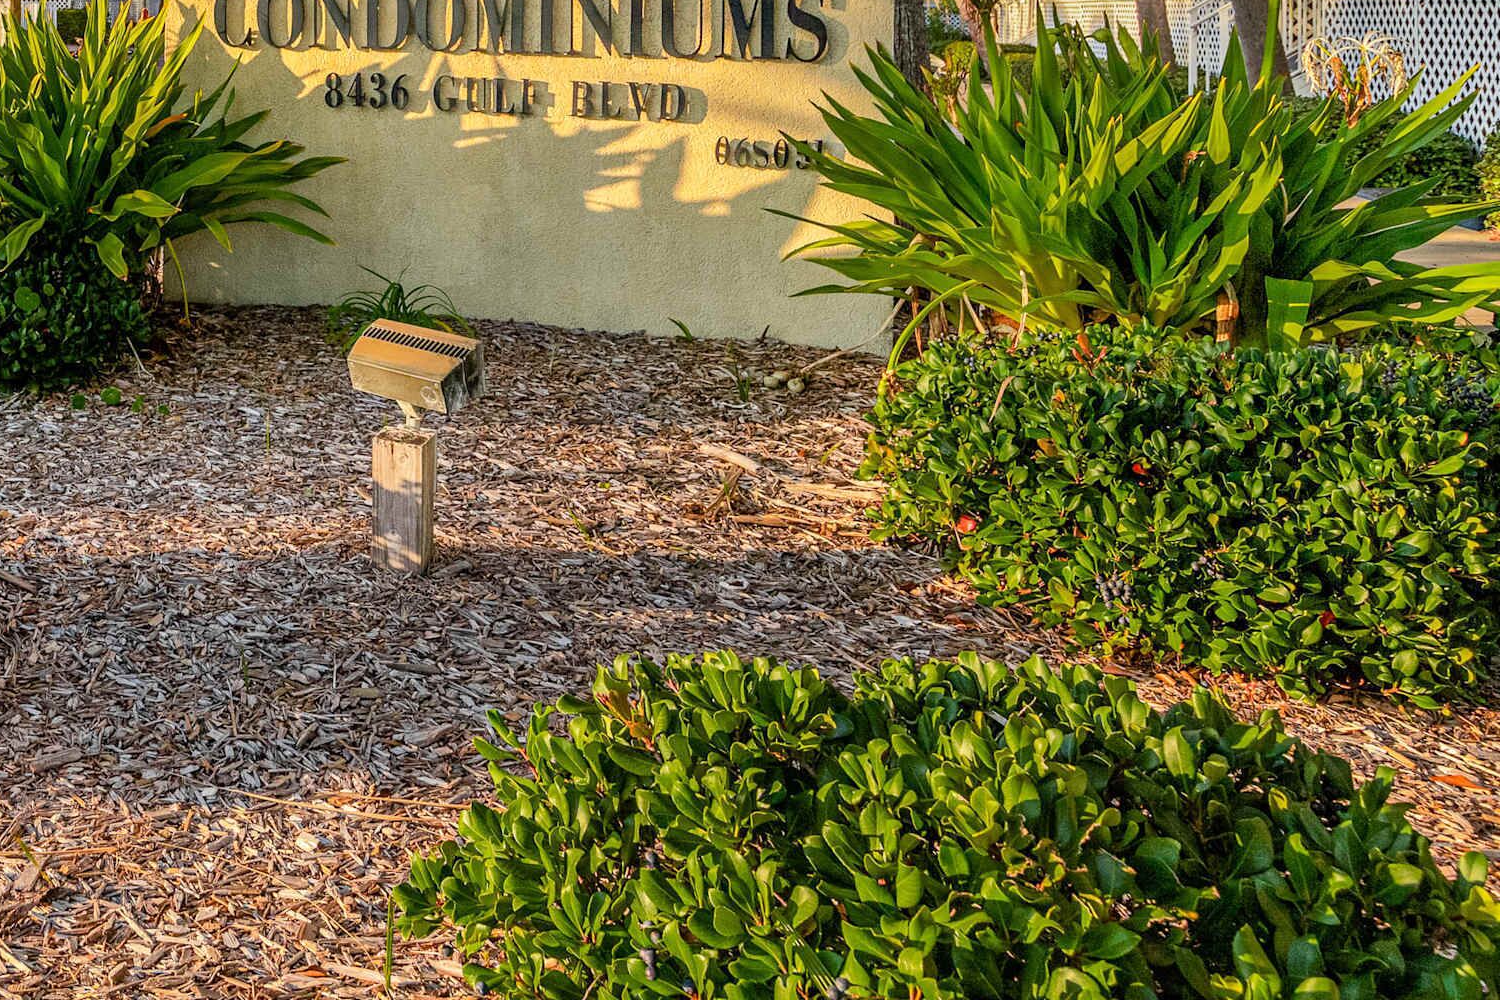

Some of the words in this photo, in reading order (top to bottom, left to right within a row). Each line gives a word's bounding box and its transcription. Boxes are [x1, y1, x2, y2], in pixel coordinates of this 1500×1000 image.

[324, 72, 410, 111] 8436
[433, 75, 537, 117] GULF
[571, 80, 687, 123] BLVD
